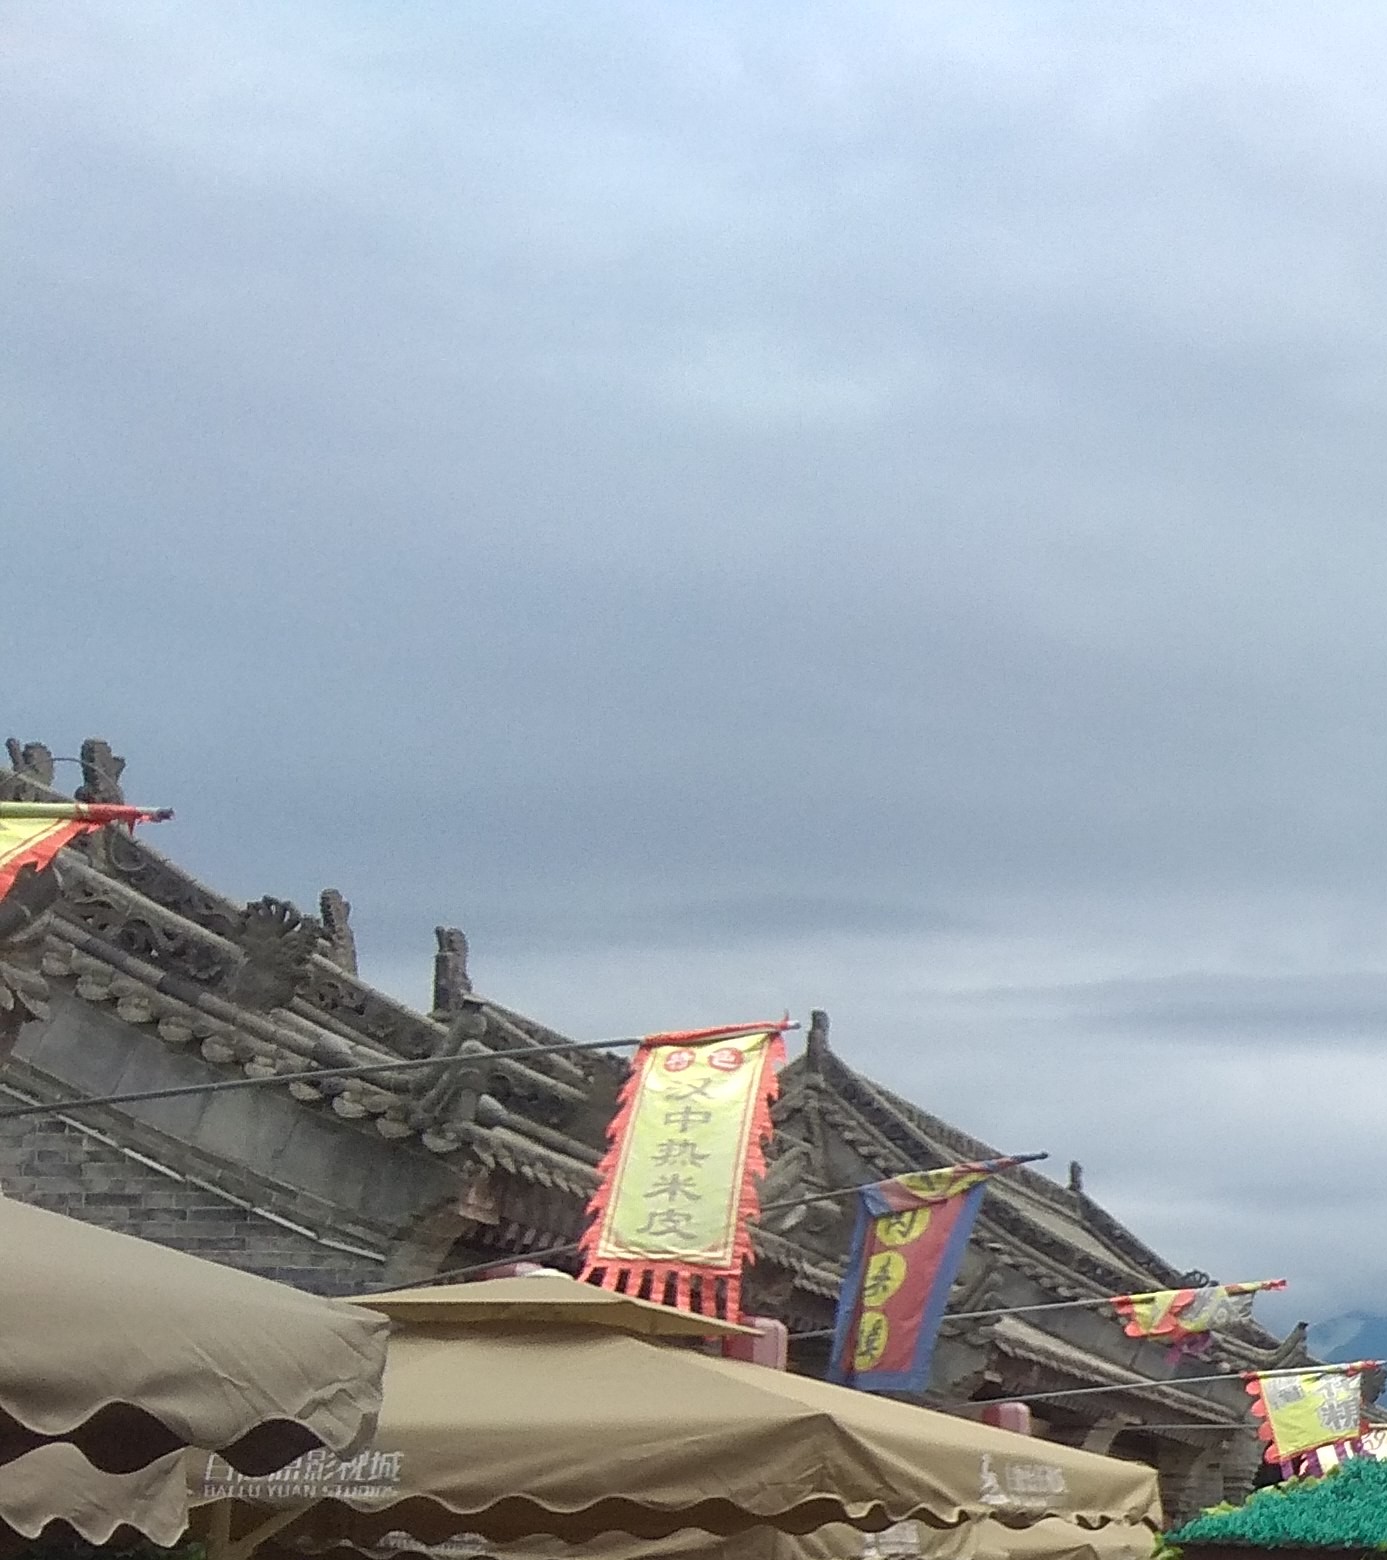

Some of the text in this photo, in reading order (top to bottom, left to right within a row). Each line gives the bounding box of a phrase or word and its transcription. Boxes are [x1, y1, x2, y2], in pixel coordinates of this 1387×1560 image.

[636, 1077, 716, 1240] 汉中热米皮
